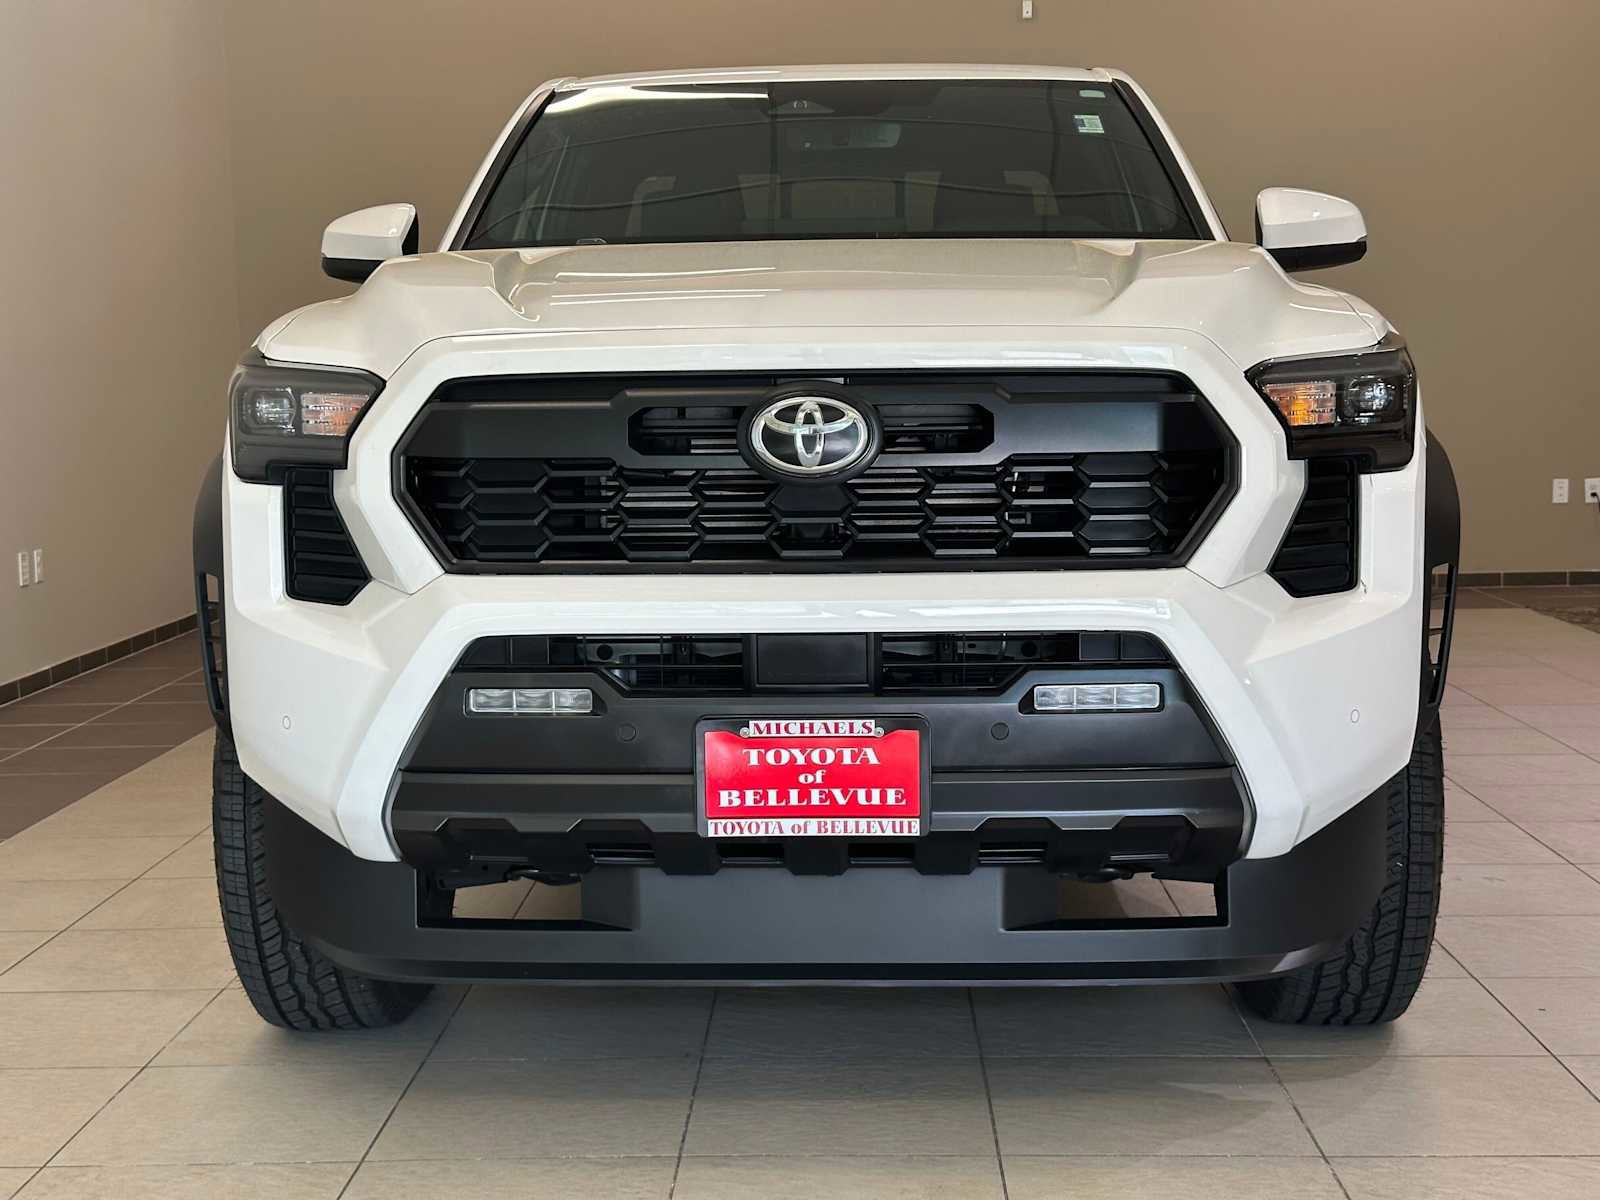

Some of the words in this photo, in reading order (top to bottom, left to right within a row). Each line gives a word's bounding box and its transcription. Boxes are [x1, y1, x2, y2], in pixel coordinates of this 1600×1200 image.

[752, 721, 874, 735] MICHAELS
[743, 747, 880, 765] TOYOTA
[798, 769, 826, 784] of
[718, 788, 906, 807] BELLEVUE
[710, 820, 785, 835] TOYOTA
[791, 820, 809, 834] of
[817, 820, 919, 834] BELLEVUE
